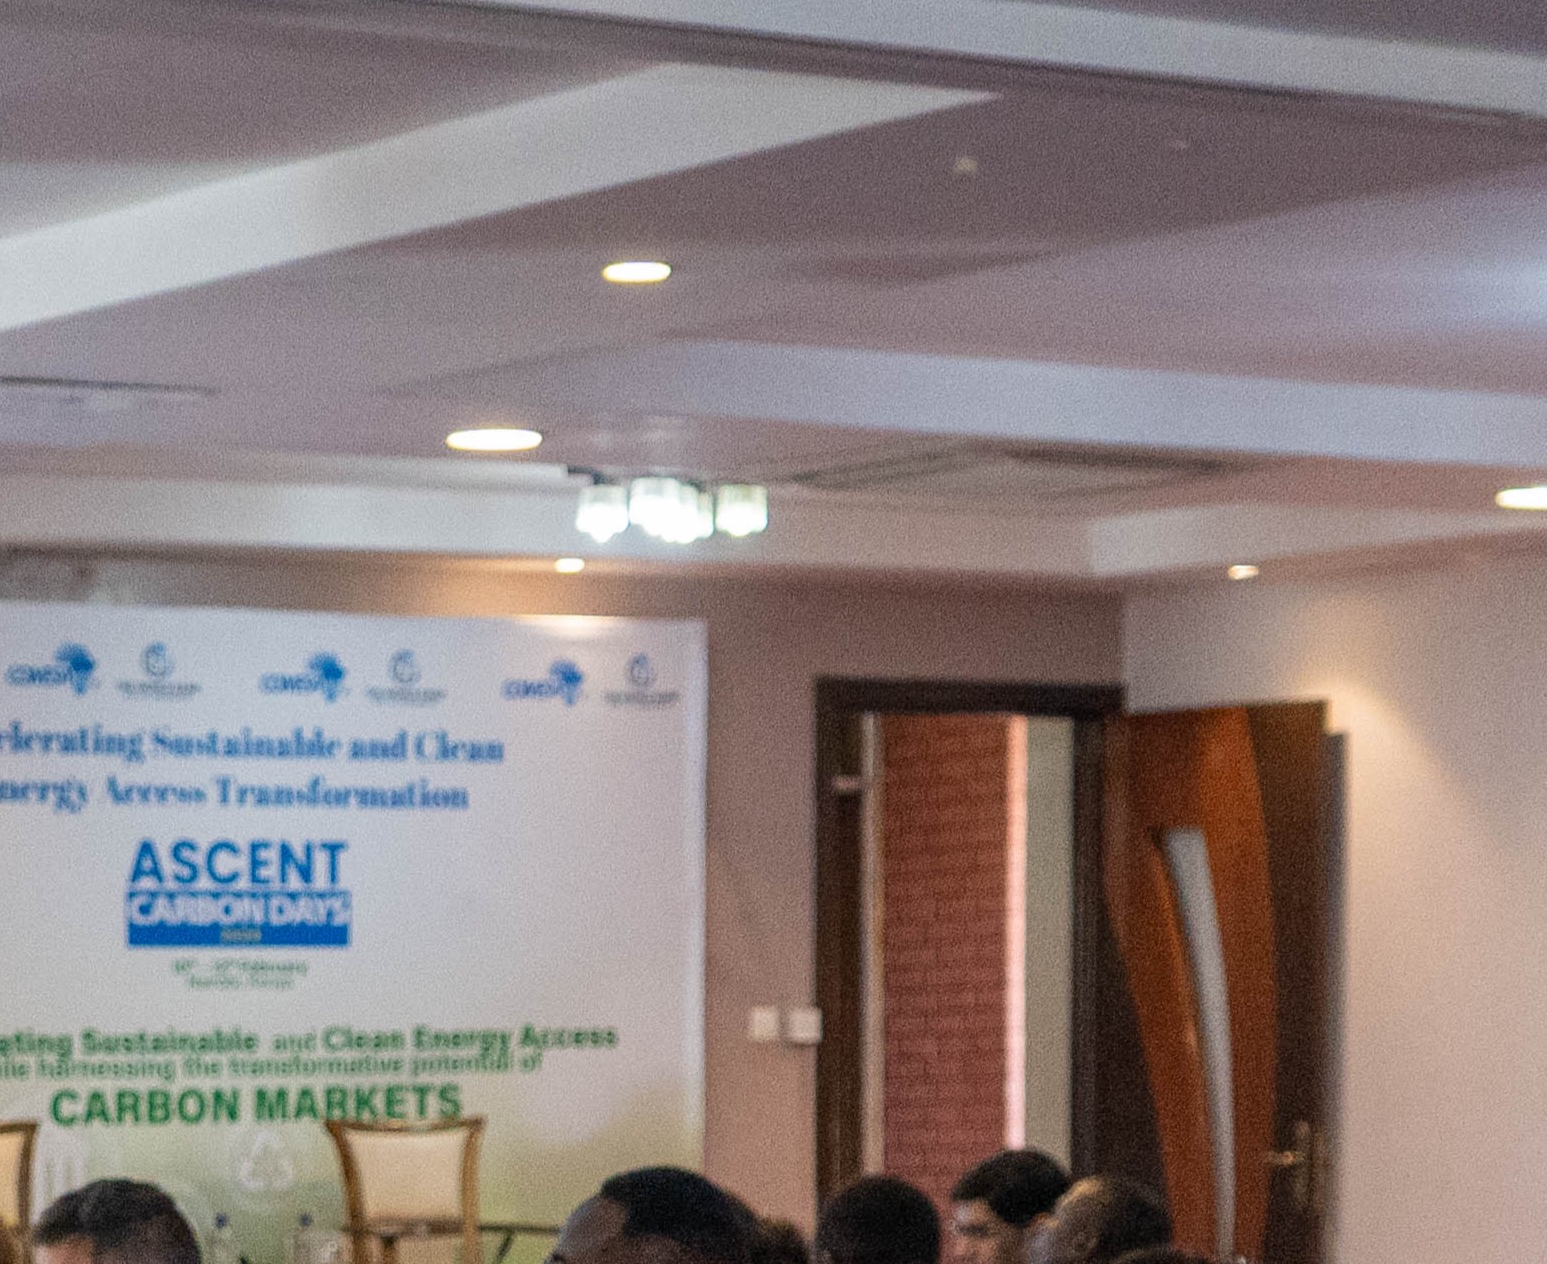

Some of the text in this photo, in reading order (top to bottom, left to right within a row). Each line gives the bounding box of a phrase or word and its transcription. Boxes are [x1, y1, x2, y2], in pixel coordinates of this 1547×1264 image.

[151, 726, 343, 760] Sustainable
[348, 729, 406, 762] and
[413, 729, 504, 764] Clean
[106, 774, 207, 805] Access
[214, 774, 468, 809] Transformation
[130, 840, 347, 884] ASCENT
[131, 893, 349, 926] CARBON DAYS
[80, 1027, 256, 1056] Sustainable
[273, 1030, 316, 1051] and
[322, 1026, 405, 1052] Clean
[411, 1026, 511, 1057] Energy
[519, 1023, 619, 1049] Access
[36, 1057, 176, 1083] harnessing
[182, 1056, 221, 1077] the
[228, 1053, 404, 1077] transformative
[410, 1050, 514, 1077] potential
[521, 1051, 542, 1073] of
[49, 1082, 463, 1126] CARBON MARKETS
